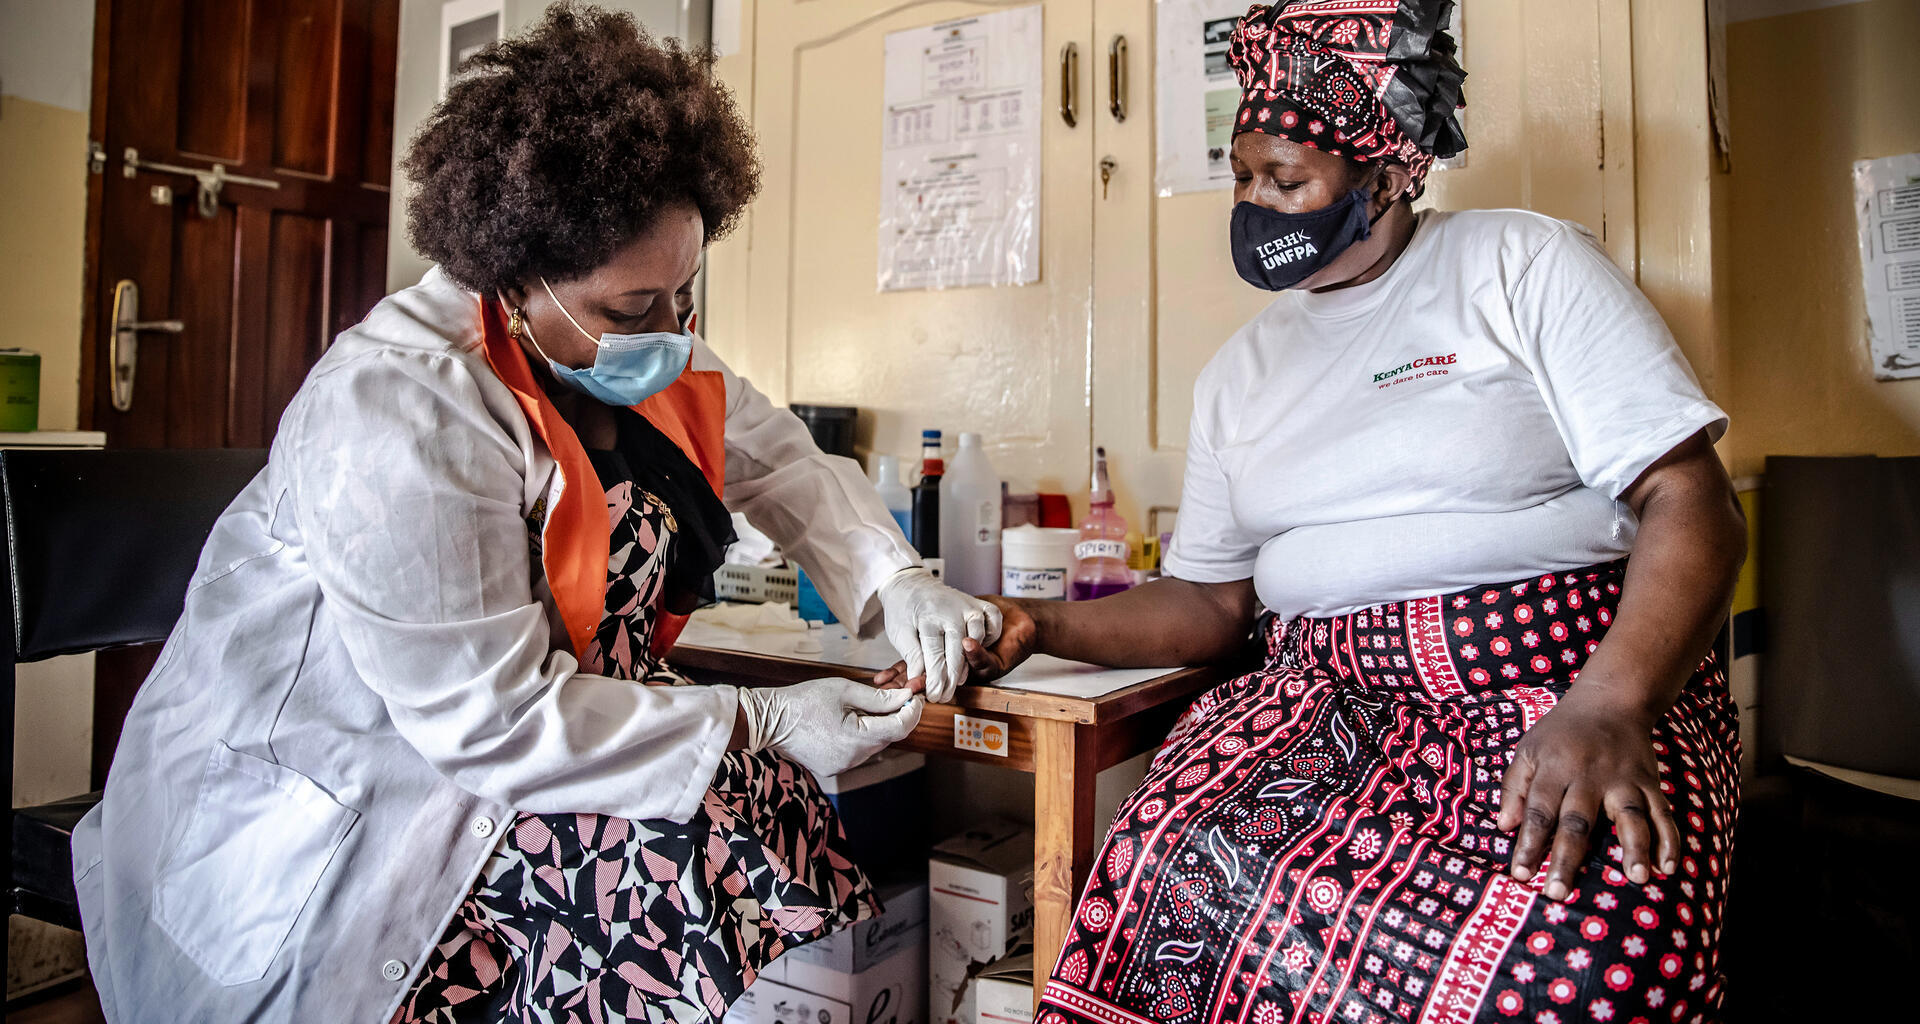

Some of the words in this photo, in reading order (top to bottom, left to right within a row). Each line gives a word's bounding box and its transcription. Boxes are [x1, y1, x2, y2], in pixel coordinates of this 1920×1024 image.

[1256, 228, 1311, 259] ICRHK
[1263, 242, 1318, 270] UNFPA
[1378, 382, 1391, 390] we
[1393, 375, 1413, 385] dare
[1426, 369, 1449, 377] care
[1079, 543, 1121, 557] SPIRIT
[1012, 908, 1034, 932] SAF
